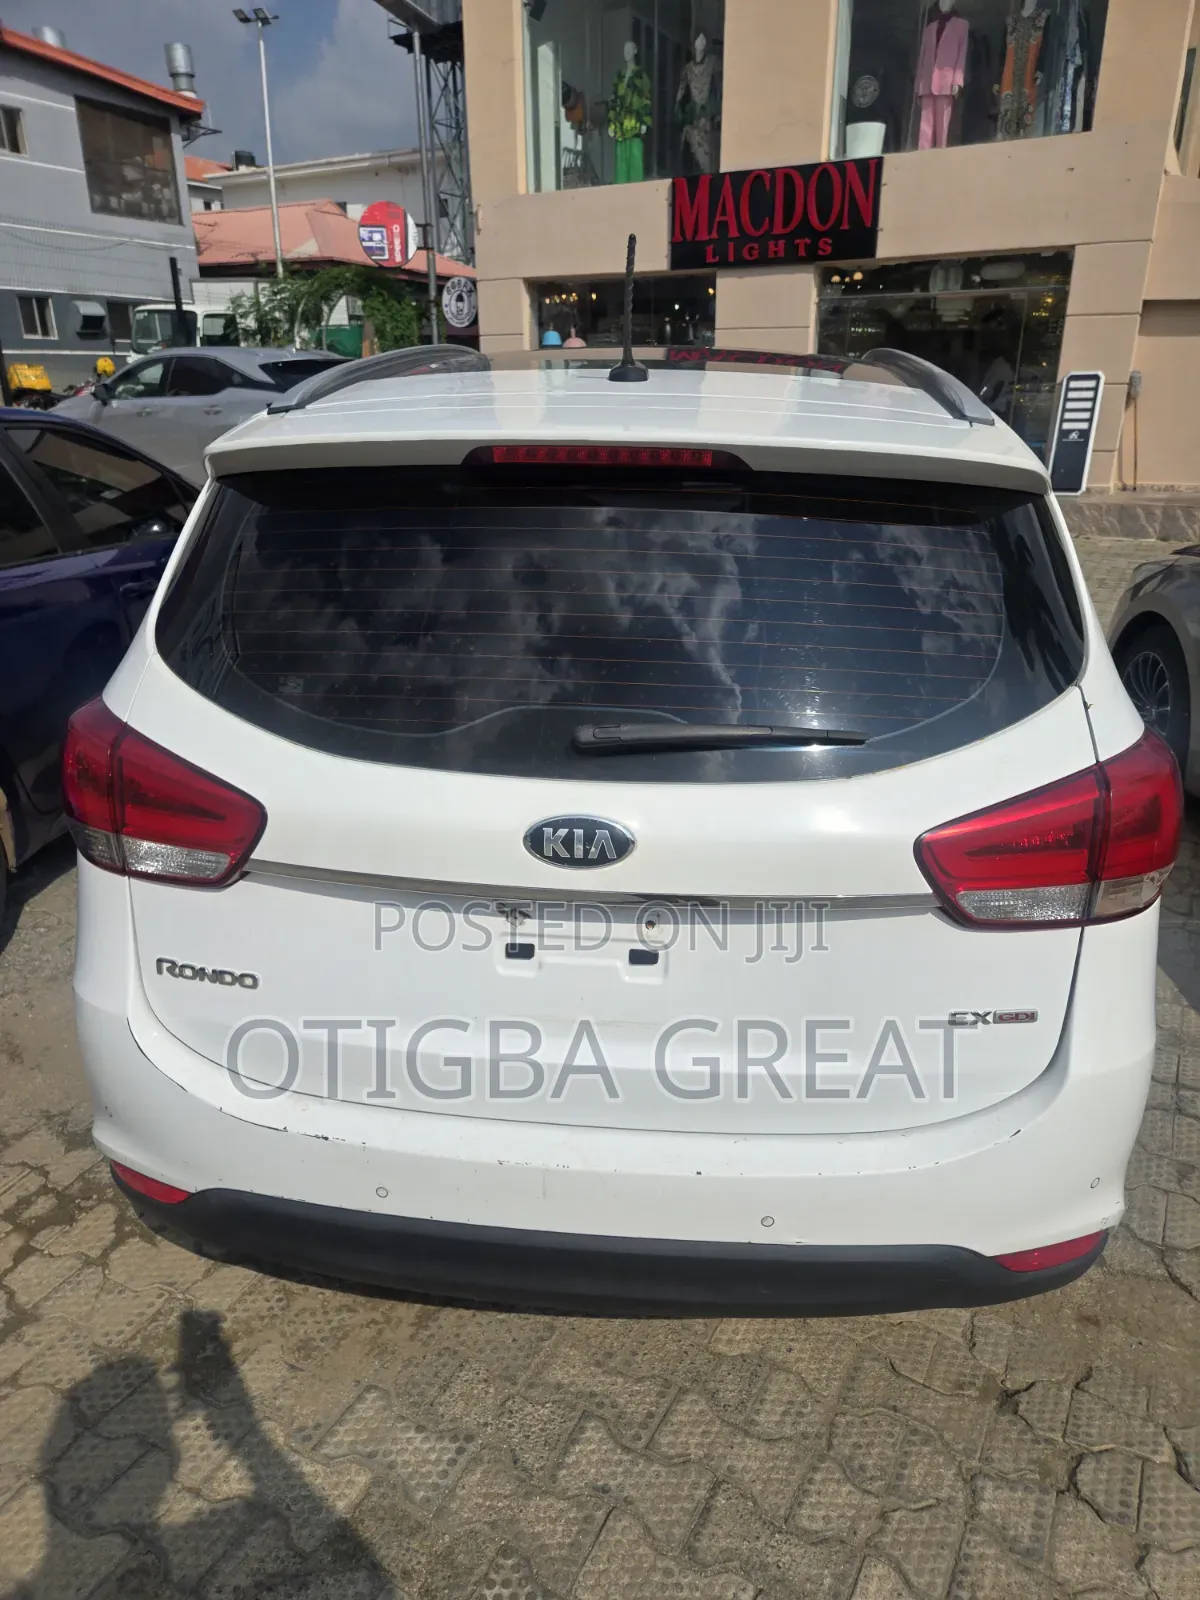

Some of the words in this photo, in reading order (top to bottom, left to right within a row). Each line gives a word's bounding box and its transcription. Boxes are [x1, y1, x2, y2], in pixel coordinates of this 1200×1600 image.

[671, 158, 879, 243] MACDON
[705, 236, 833, 263] LIGHTS
[542, 826, 617, 860] KIA
[155, 957, 260, 990] RONDO
[948, 1009, 992, 1026] EX
[997, 1011, 1036, 1023] GDI
